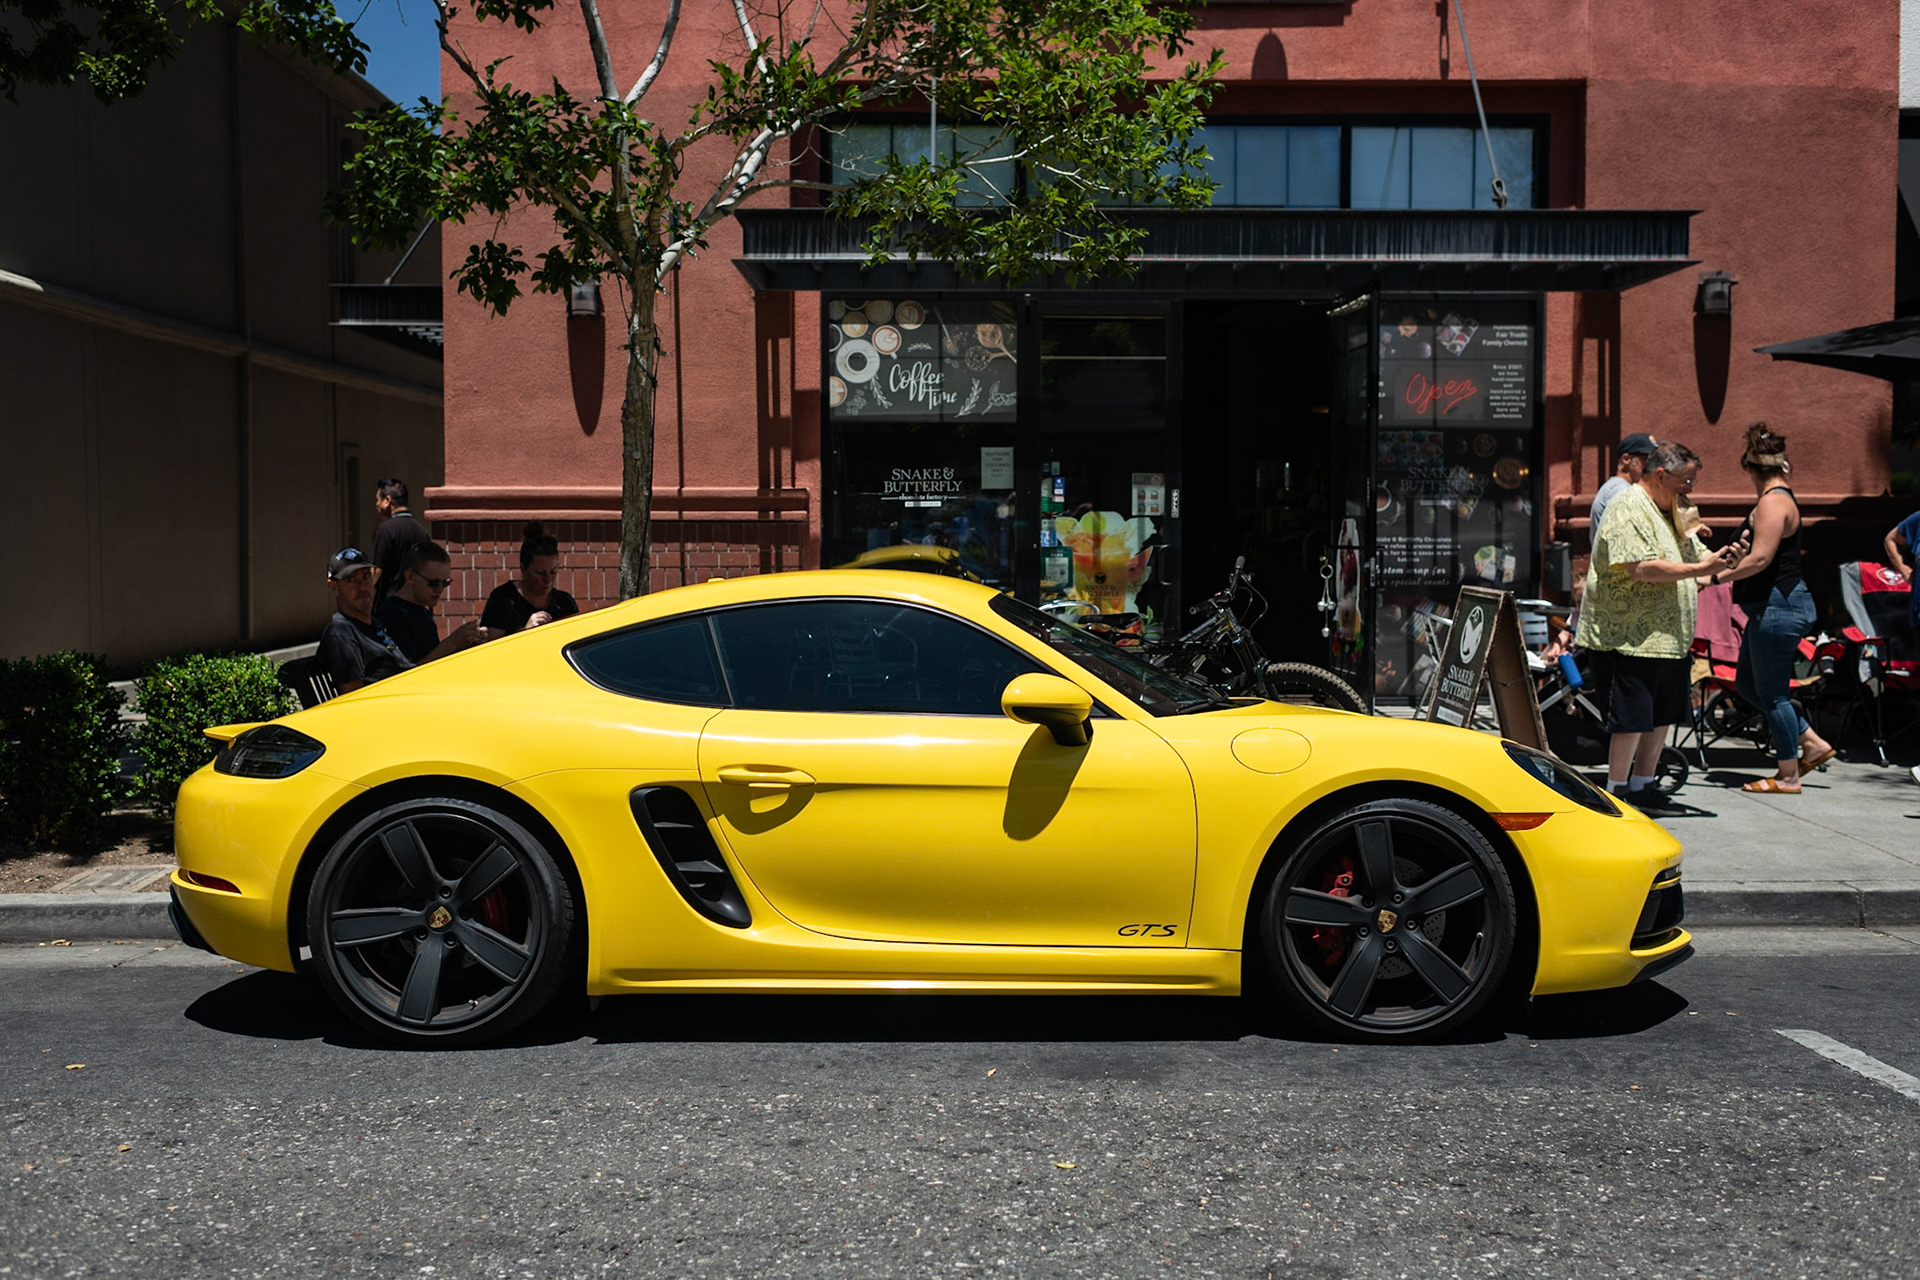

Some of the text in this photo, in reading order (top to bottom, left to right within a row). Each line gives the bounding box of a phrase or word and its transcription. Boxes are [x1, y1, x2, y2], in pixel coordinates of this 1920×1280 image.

[1482, 339, 1502, 347] Family
[889, 361, 946, 402] Coffee
[922, 386, 958, 410] time
[1406, 373, 1478, 415] Open
[883, 481, 962, 493] BUTTERFLY
[926, 493, 948, 501] factory
[1376, 564, 1403, 574] stom
[1432, 566, 1446, 576] for
[1390, 577, 1421, 588] special
[1440, 677, 1472, 701] BUTTERFLY
[1118, 924, 1177, 936] GTS
